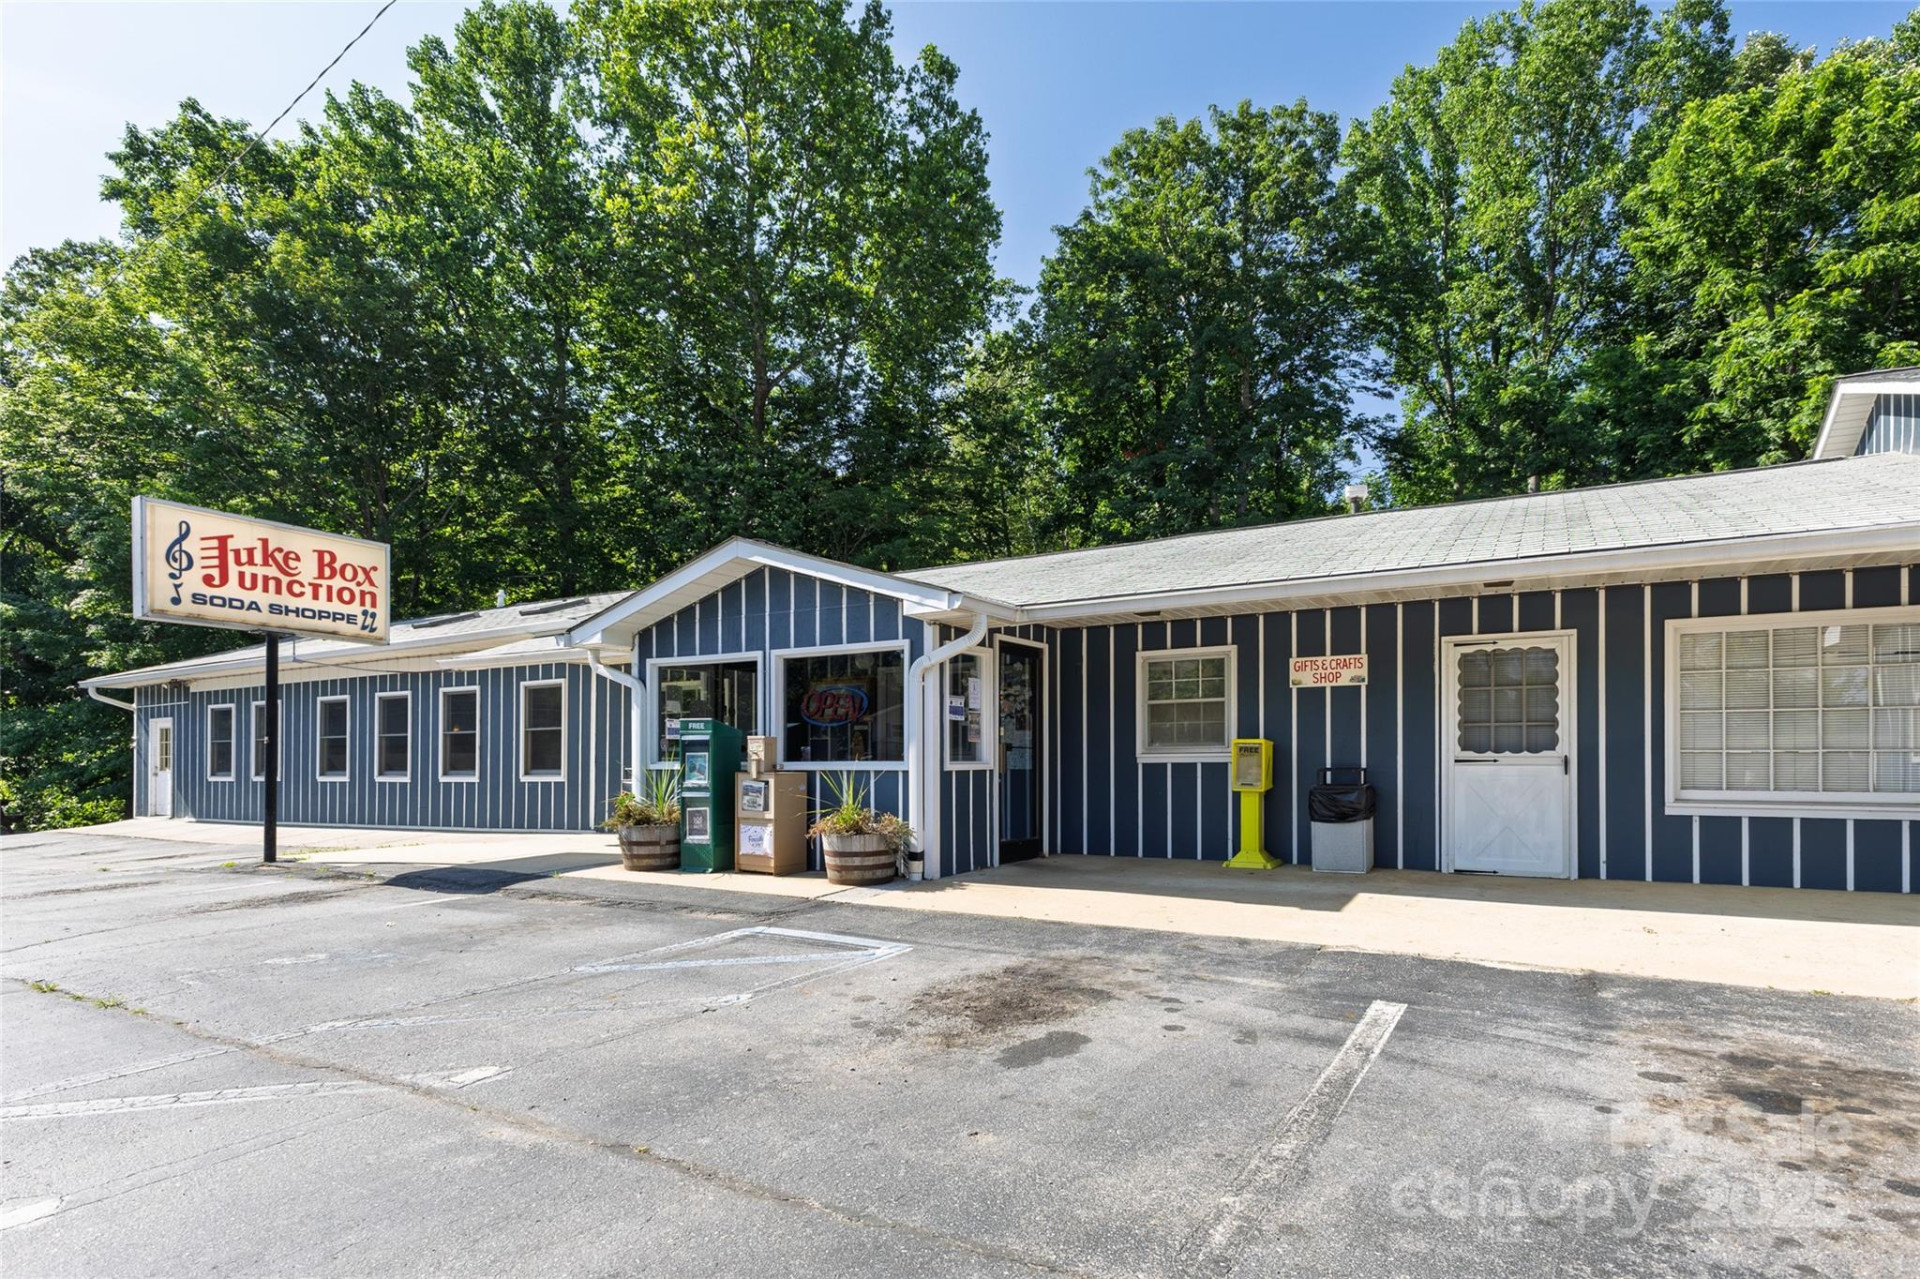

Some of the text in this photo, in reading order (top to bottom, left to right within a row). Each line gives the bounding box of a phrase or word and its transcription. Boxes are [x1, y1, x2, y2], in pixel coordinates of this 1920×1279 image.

[200, 534, 379, 589] Juke Box
[191, 592, 358, 625] SODA SHOPPE
[1293, 657, 1364, 672] GIFTS & CRAFTS
[1312, 671, 1342, 684] SHOP
[801, 689, 861, 721] OPEN
[688, 722, 705, 730] FREE
[1239, 746, 1260, 754] FREE
